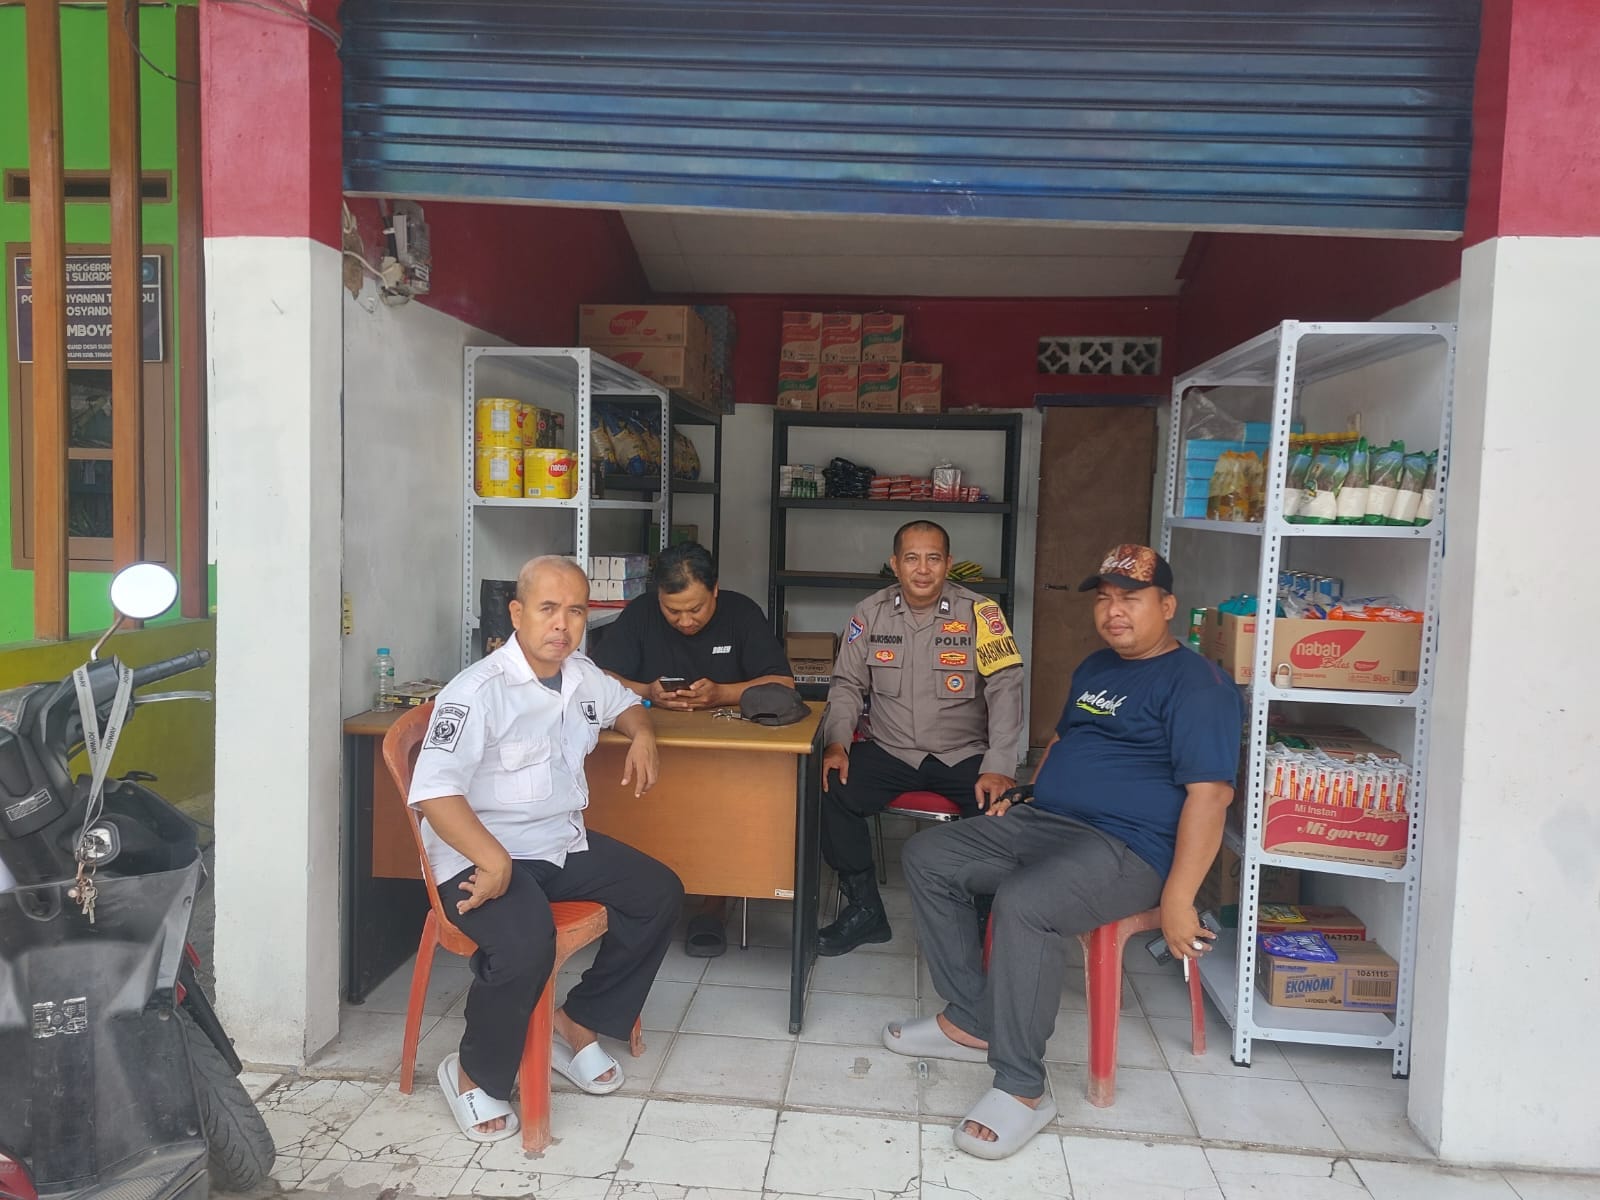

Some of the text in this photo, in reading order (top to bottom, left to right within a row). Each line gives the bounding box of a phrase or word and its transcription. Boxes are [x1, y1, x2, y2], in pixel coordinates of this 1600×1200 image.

[934, 636, 972, 647] POLRI
[1295, 641, 1341, 658] nabati
[1294, 803, 1337, 817] Mi Instan
[1297, 821, 1389, 847] Mi goreng
[1285, 978, 1335, 993] EKONOMI
